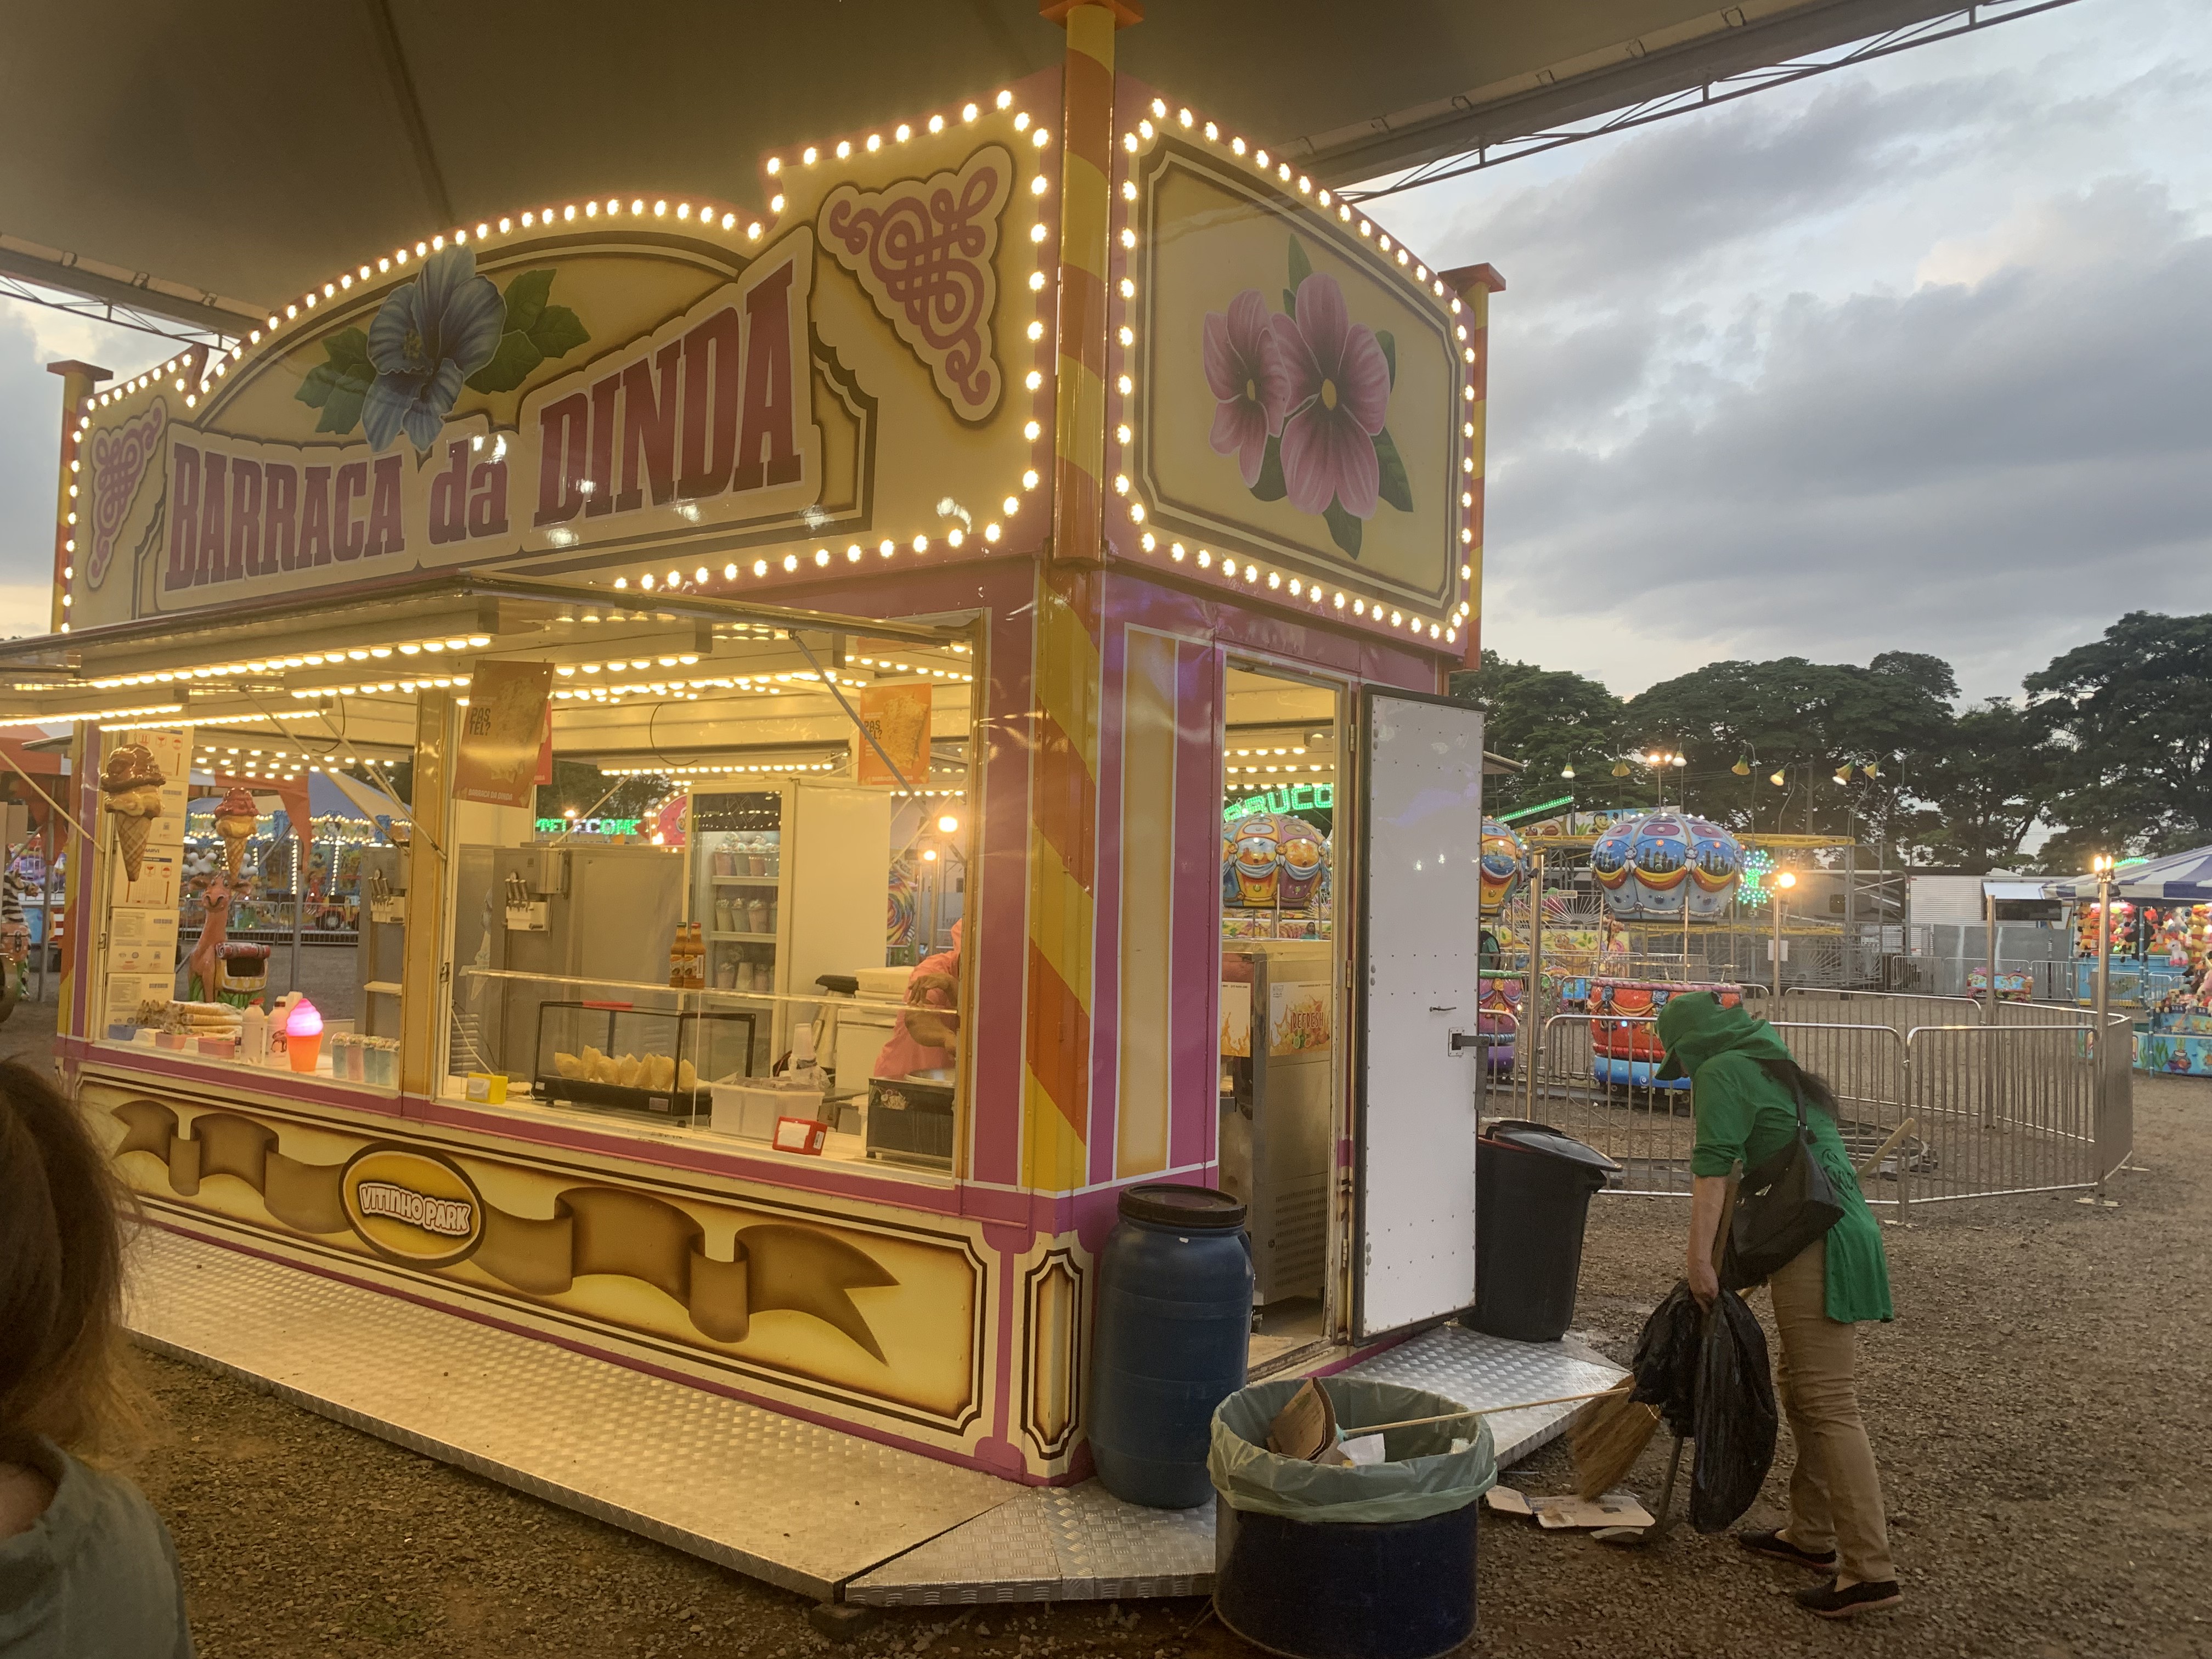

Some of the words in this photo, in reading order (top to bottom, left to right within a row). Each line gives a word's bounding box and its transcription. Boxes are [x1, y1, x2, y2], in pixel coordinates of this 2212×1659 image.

[165, 442, 405, 591] BARRACA
[430, 437, 509, 545] da
[533, 259, 802, 528] DINDA
[470, 707, 491, 722] PAS
[470, 721, 491, 736] TEL?
[469, 788, 490, 798] BARRACA
[361, 1186, 424, 1220] VITINHO
[425, 1200, 469, 1231] PARK
